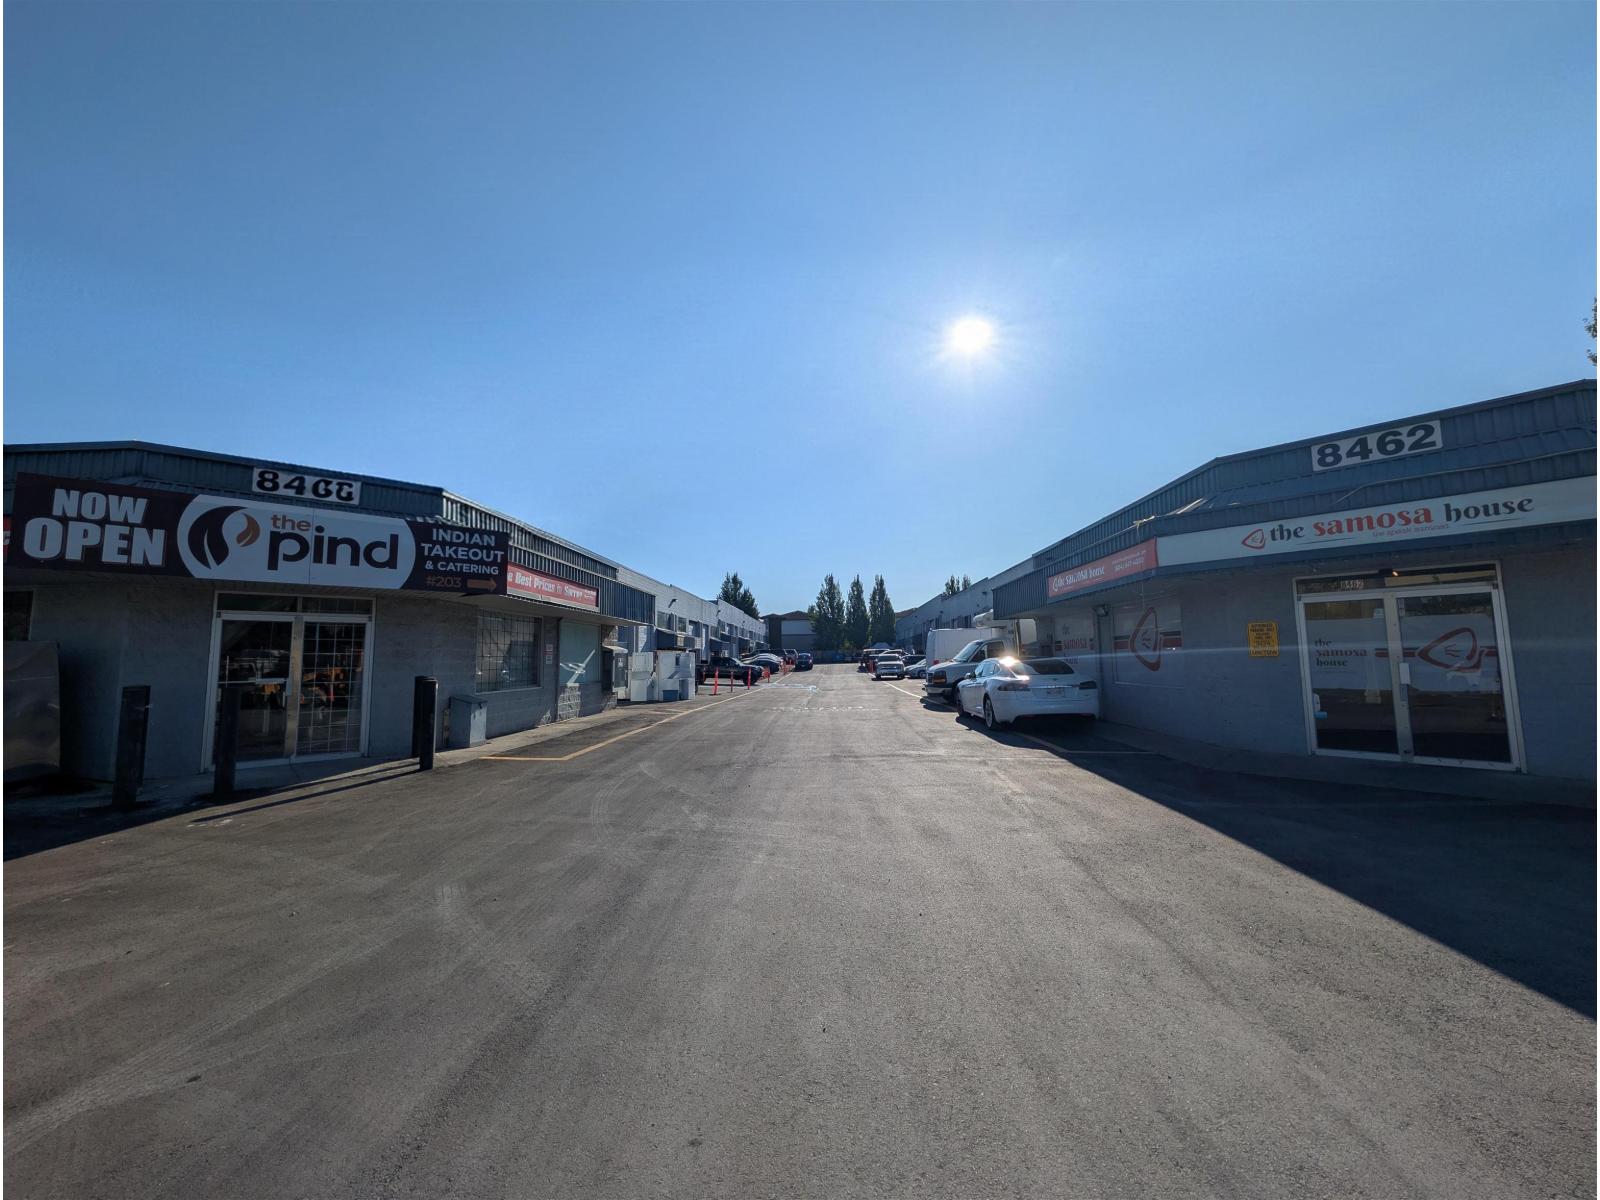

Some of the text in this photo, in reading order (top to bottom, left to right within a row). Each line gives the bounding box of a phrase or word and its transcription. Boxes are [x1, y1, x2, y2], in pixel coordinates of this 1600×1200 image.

[1315, 423, 1438, 467] 8462
[52, 488, 149, 524] NOW
[270, 514, 312, 531] the
[1269, 497, 1535, 542] the samosa house
[23, 517, 166, 567] OPEN
[432, 528, 496, 547] INDIAN
[267, 525, 399, 571] pind
[421, 543, 505, 563] TAKEOUT
[425, 561, 500, 576] & CATERING
[426, 576, 461, 588] #203
[515, 572, 532, 587] Best
[533, 576, 556, 593] Prices
[1314, 639, 1333, 648] the
[1315, 649, 1369, 658] samosa
[1316, 658, 1350, 668] house
